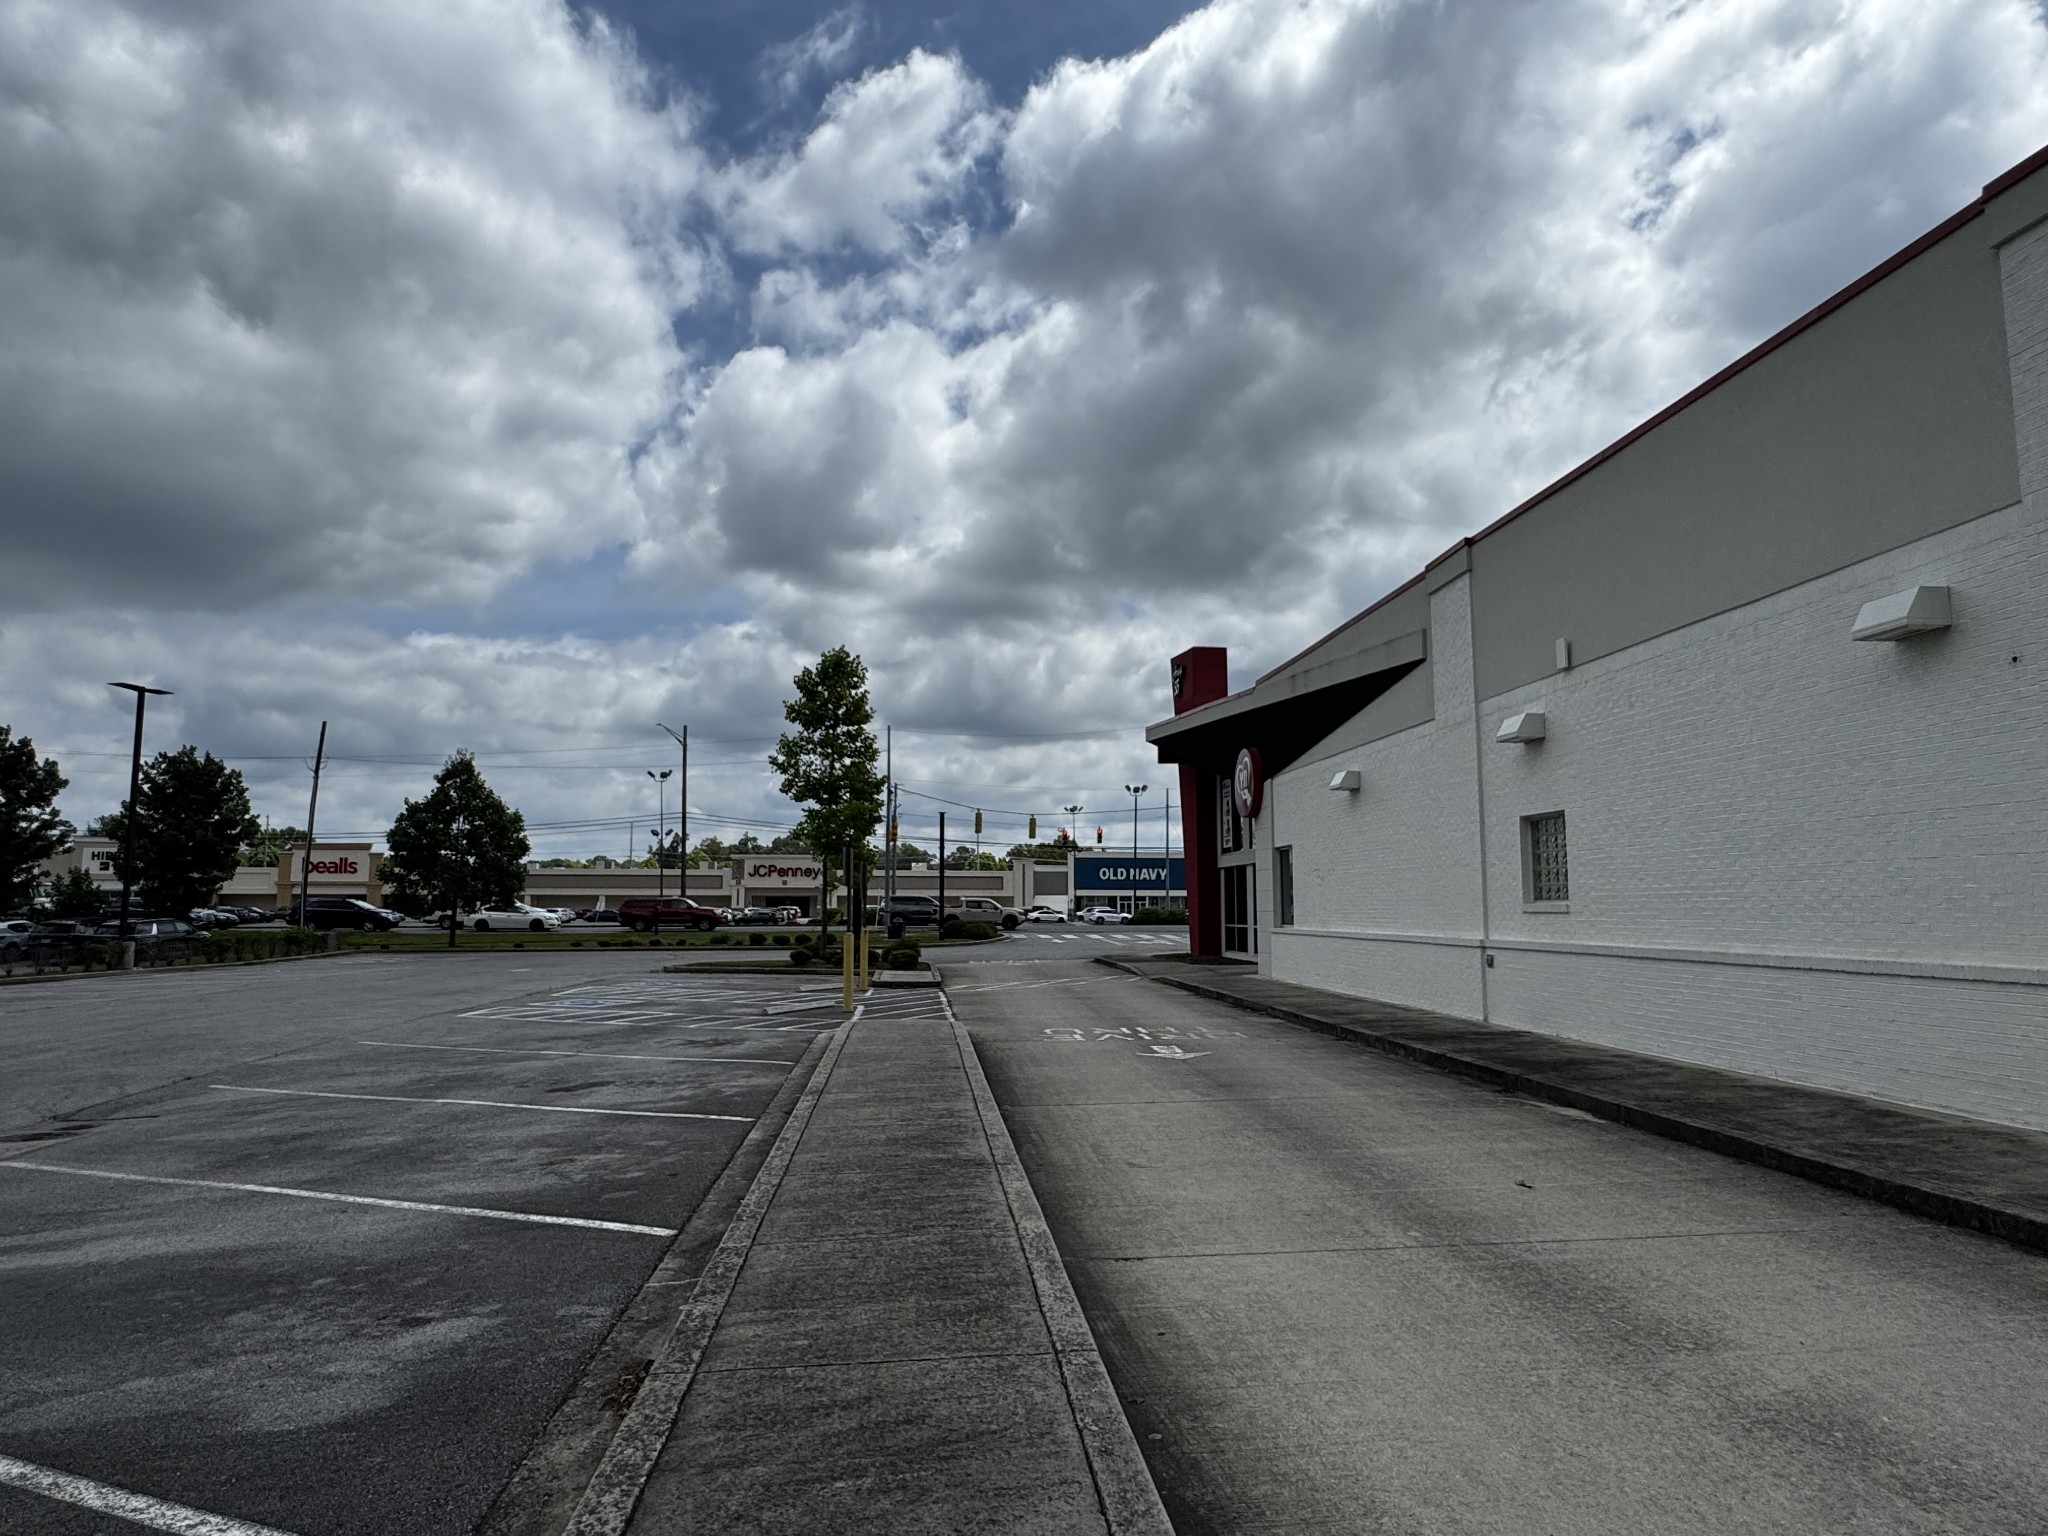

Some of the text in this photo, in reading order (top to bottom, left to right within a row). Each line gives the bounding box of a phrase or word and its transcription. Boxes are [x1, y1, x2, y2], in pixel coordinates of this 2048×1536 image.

[302, 857, 358, 874] bealls
[748, 864, 821, 880] JCPenney
[1098, 867, 1168, 881] OLD NAVY
